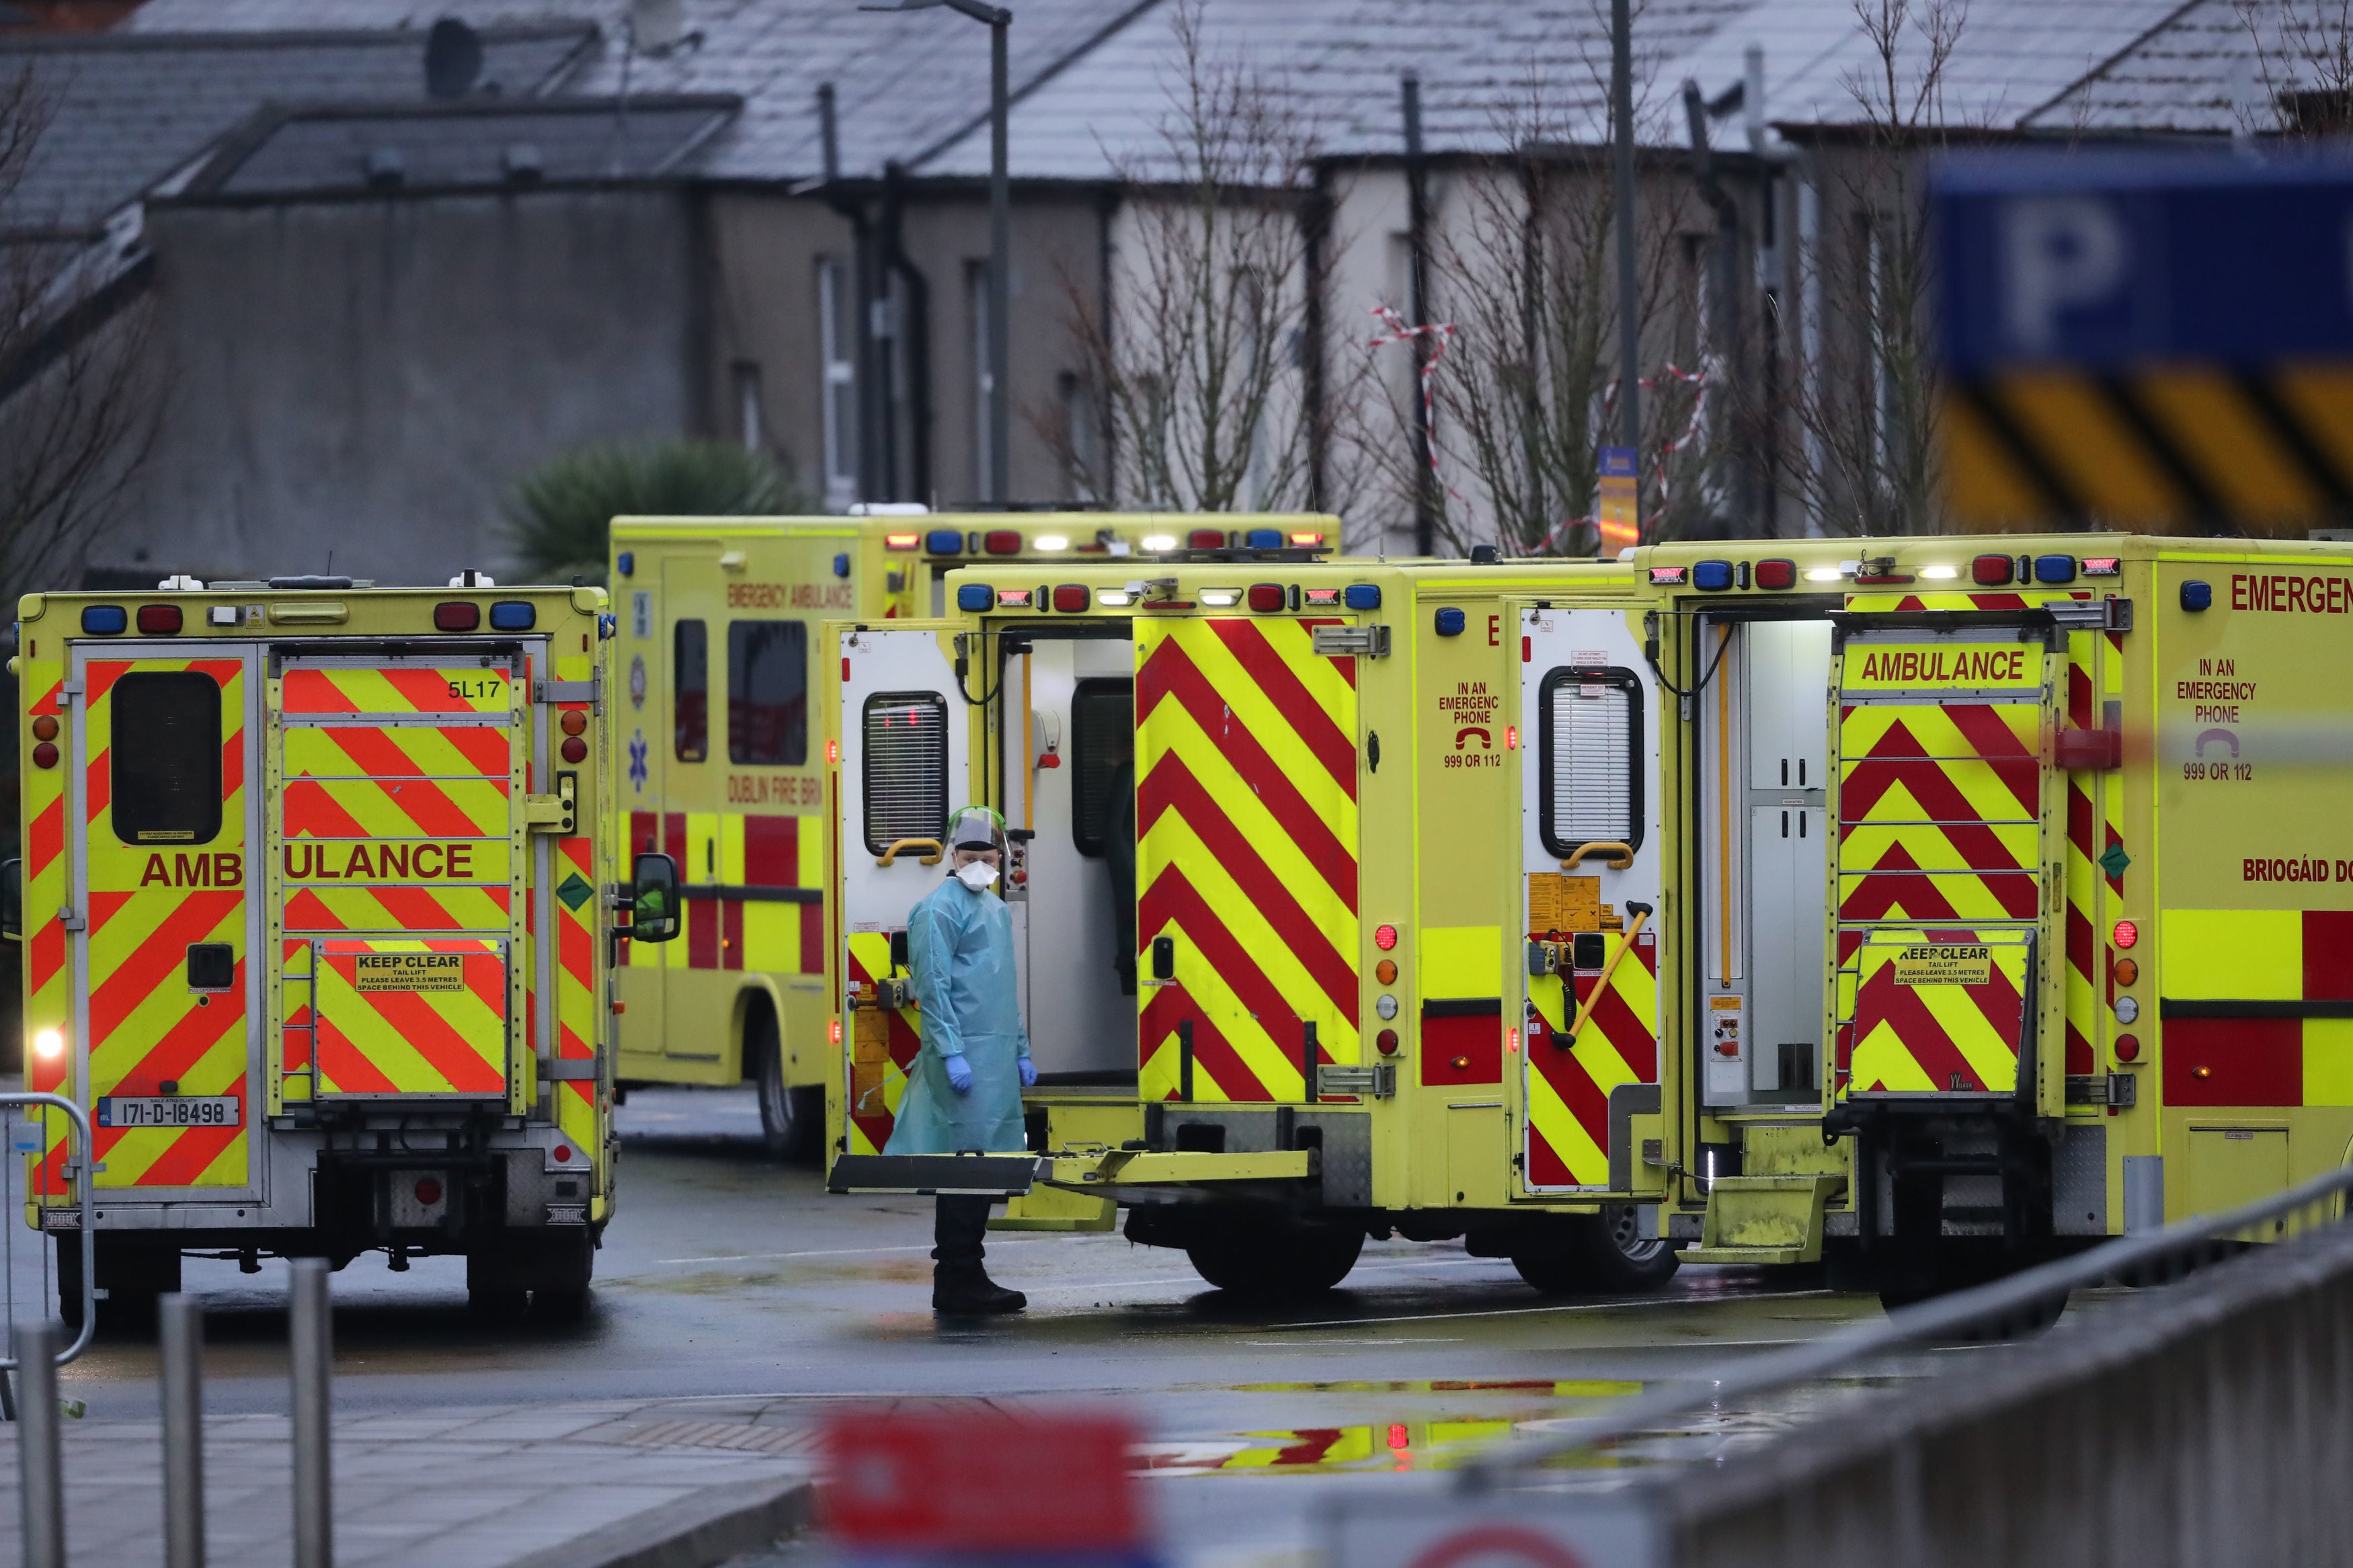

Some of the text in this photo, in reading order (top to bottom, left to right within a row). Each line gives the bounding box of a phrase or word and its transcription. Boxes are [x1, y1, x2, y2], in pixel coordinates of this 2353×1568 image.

[2003, 196, 2124, 347] P
[728, 583, 852, 609] EMERGENCY AMBULANCE
[1862, 651, 2024, 681] AMBULANCE
[2200, 659, 2234, 676] IN AN
[448, 681, 500, 698] 5L17
[1458, 682, 1486, 695] IN AN
[2178, 682, 2256, 700] EMERGENCY
[1439, 696, 1500, 710] EMERGENC
[1454, 711, 1490, 724] PHONE
[2196, 705, 2239, 723] PHONE
[1444, 754, 1500, 768] 999 OR 112
[2184, 762, 2251, 780] 999 OR 112
[729, 775, 768, 803] DUBLIN
[772, 776, 797, 804] FIRE
[140, 843, 473, 887] AMB ULANCE
[2243, 854, 2329, 882] BRIOGÁID
[359, 956, 460, 968] KEEP CLEAR
[1940, 948, 1988, 959] CLEAR
[123, 1103, 225, 1124] 171-D-18498
